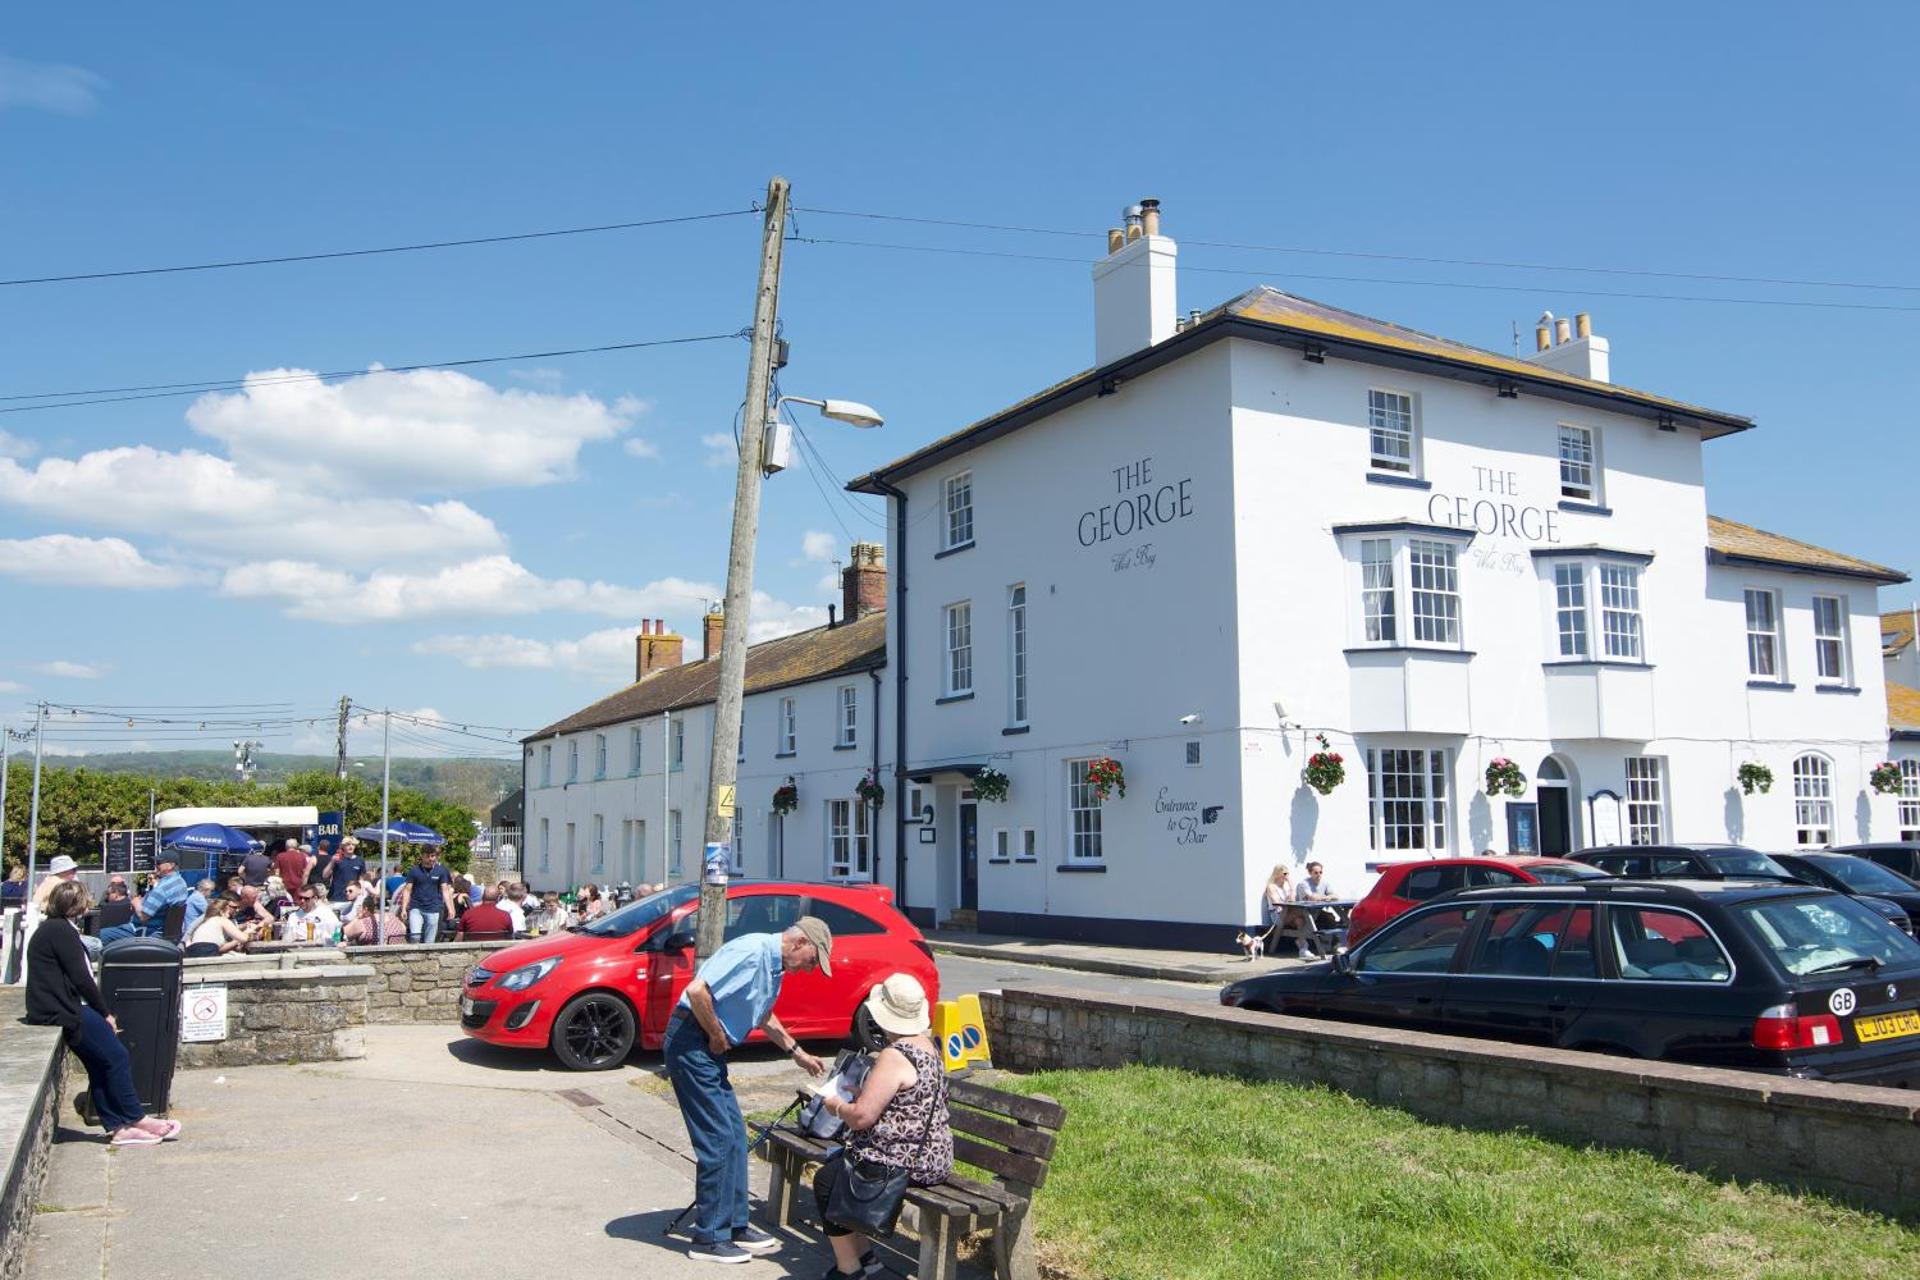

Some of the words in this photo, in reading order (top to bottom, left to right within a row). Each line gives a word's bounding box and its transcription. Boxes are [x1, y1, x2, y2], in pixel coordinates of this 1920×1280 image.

[1113, 457, 1152, 493] THE
[1472, 465, 1519, 496] THE
[1078, 478, 1193, 547] GEORGE
[1428, 493, 1560, 544] GEORGE
[1155, 786, 1198, 813] Entrance
[184, 834, 222, 845] PALMERS
[318, 823, 339, 836] BAR
[1177, 816, 1208, 845] Bar
[1832, 992, 1852, 1012] GB
